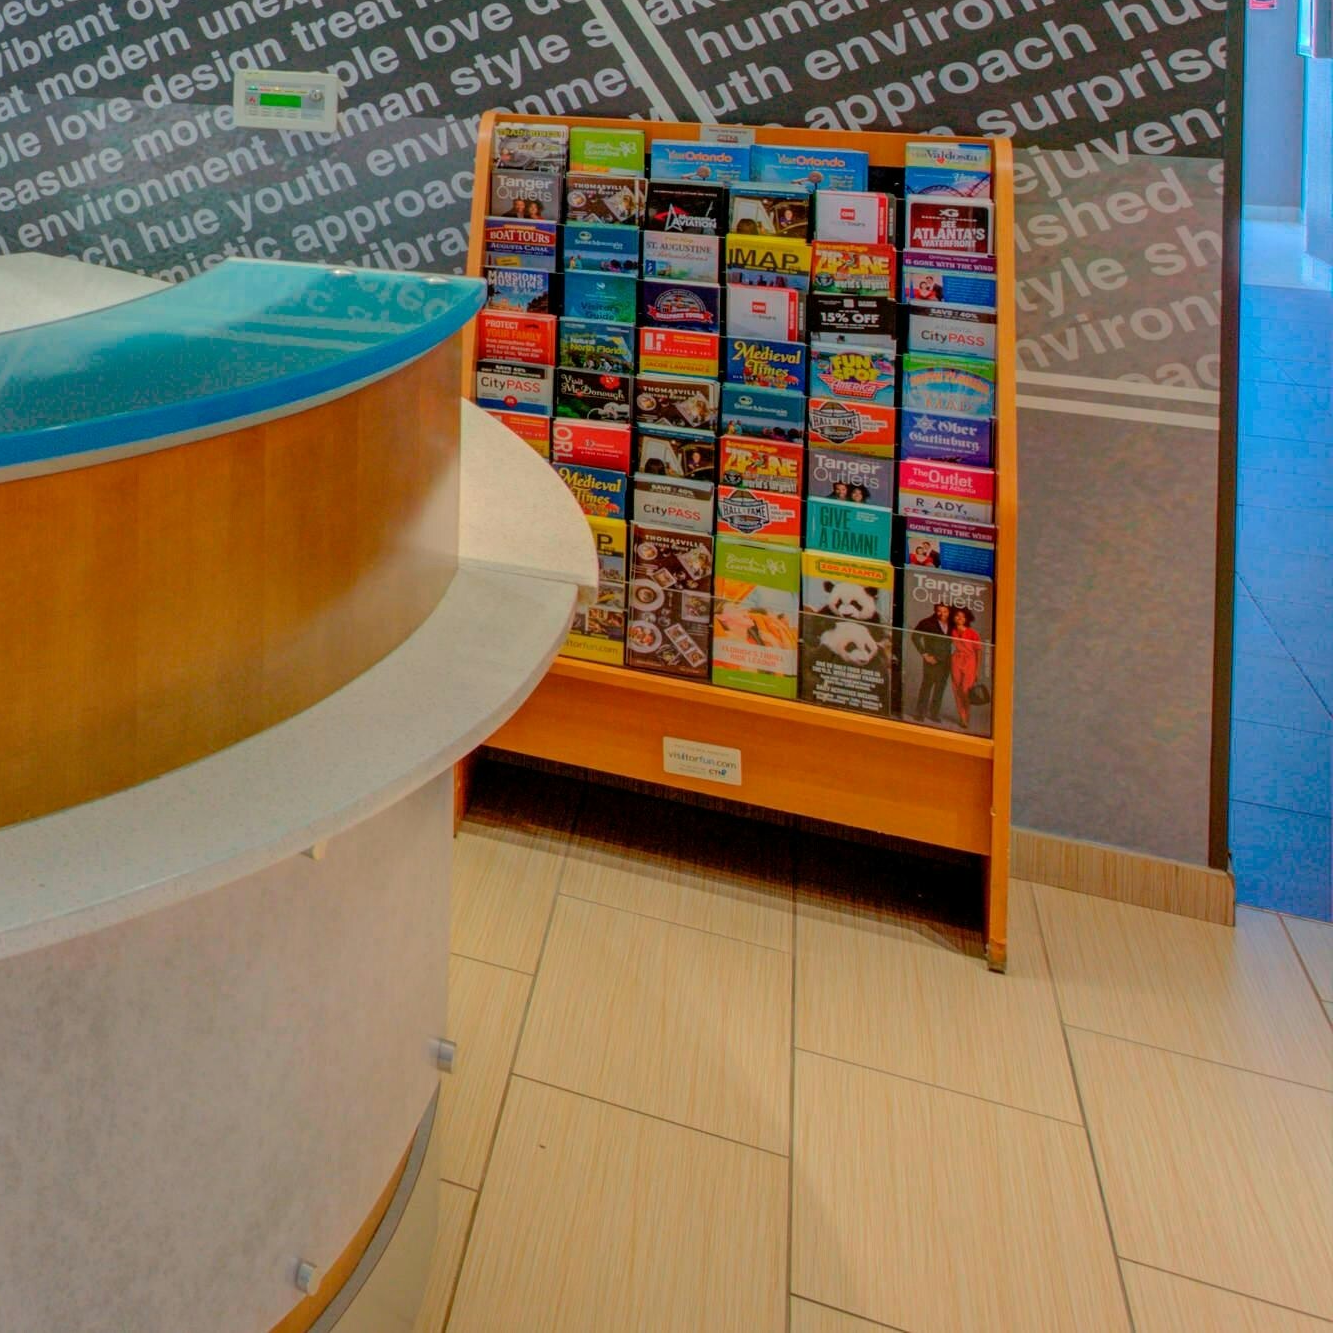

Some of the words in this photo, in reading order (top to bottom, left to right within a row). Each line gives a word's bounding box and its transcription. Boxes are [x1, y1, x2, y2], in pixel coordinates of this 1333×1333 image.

[35, 25, 191, 105] modern
[133, 104, 237, 162] more
[405, 2, 513, 60] love
[805, 20, 1097, 131] approach
[46, 96, 134, 146] love
[142, 34, 286, 109] design
[18, 135, 274, 248] environment
[279, 80, 442, 157] human
[450, 33, 571, 96] style
[497, 176, 553, 190] Tanger
[497, 186, 552, 202] Outlets
[137, 206, 221, 254] hue
[227, 158, 358, 232] youth
[490, 230, 514, 241] BOAT
[518, 231, 550, 243] TOURS
[913, 228, 985, 241] ATLANTA'S
[660, 243, 712, 254] AUGUSTINE
[921, 239, 977, 248] WATERFRONT
[488, 270, 543, 283] MANSIONS
[485, 319, 519, 329] PROTECT
[820, 312, 849, 323] 15%
[852, 313, 880, 324] OFF
[511, 330, 542, 341] FAMILY
[921, 330, 985, 347] CityPASS
[571, 344, 594, 352] North
[733, 341, 801, 364] Medieval
[746, 361, 789, 377] Times
[832, 354, 871, 368] FUN
[834, 367, 880, 381] SPOT
[481, 377, 541, 394] CityPASS
[643, 386, 701, 396] THOMASVILLE
[813, 417, 832, 427] HALL
[837, 418, 857, 428] FAME
[814, 454, 881, 475] Tanger
[559, 467, 621, 492] Medieval
[814, 467, 879, 489] Outlets
[912, 467, 928, 476] The
[928, 470, 973, 488] Outlet
[572, 487, 610, 505] Times
[643, 504, 701, 521] CityPASS
[724, 505, 741, 516] HALL
[747, 506, 765, 517] FAME
[820, 506, 851, 530] GIVE
[645, 534, 704, 547] THOMASVILLE
[820, 528, 828, 548] A
[834, 530, 878, 556] DAMN!
[821, 563, 839, 573] ZOO
[841, 566, 882, 578] ATLANTA
[913, 574, 987, 596] Tanger
[912, 586, 985, 612] Outlets
